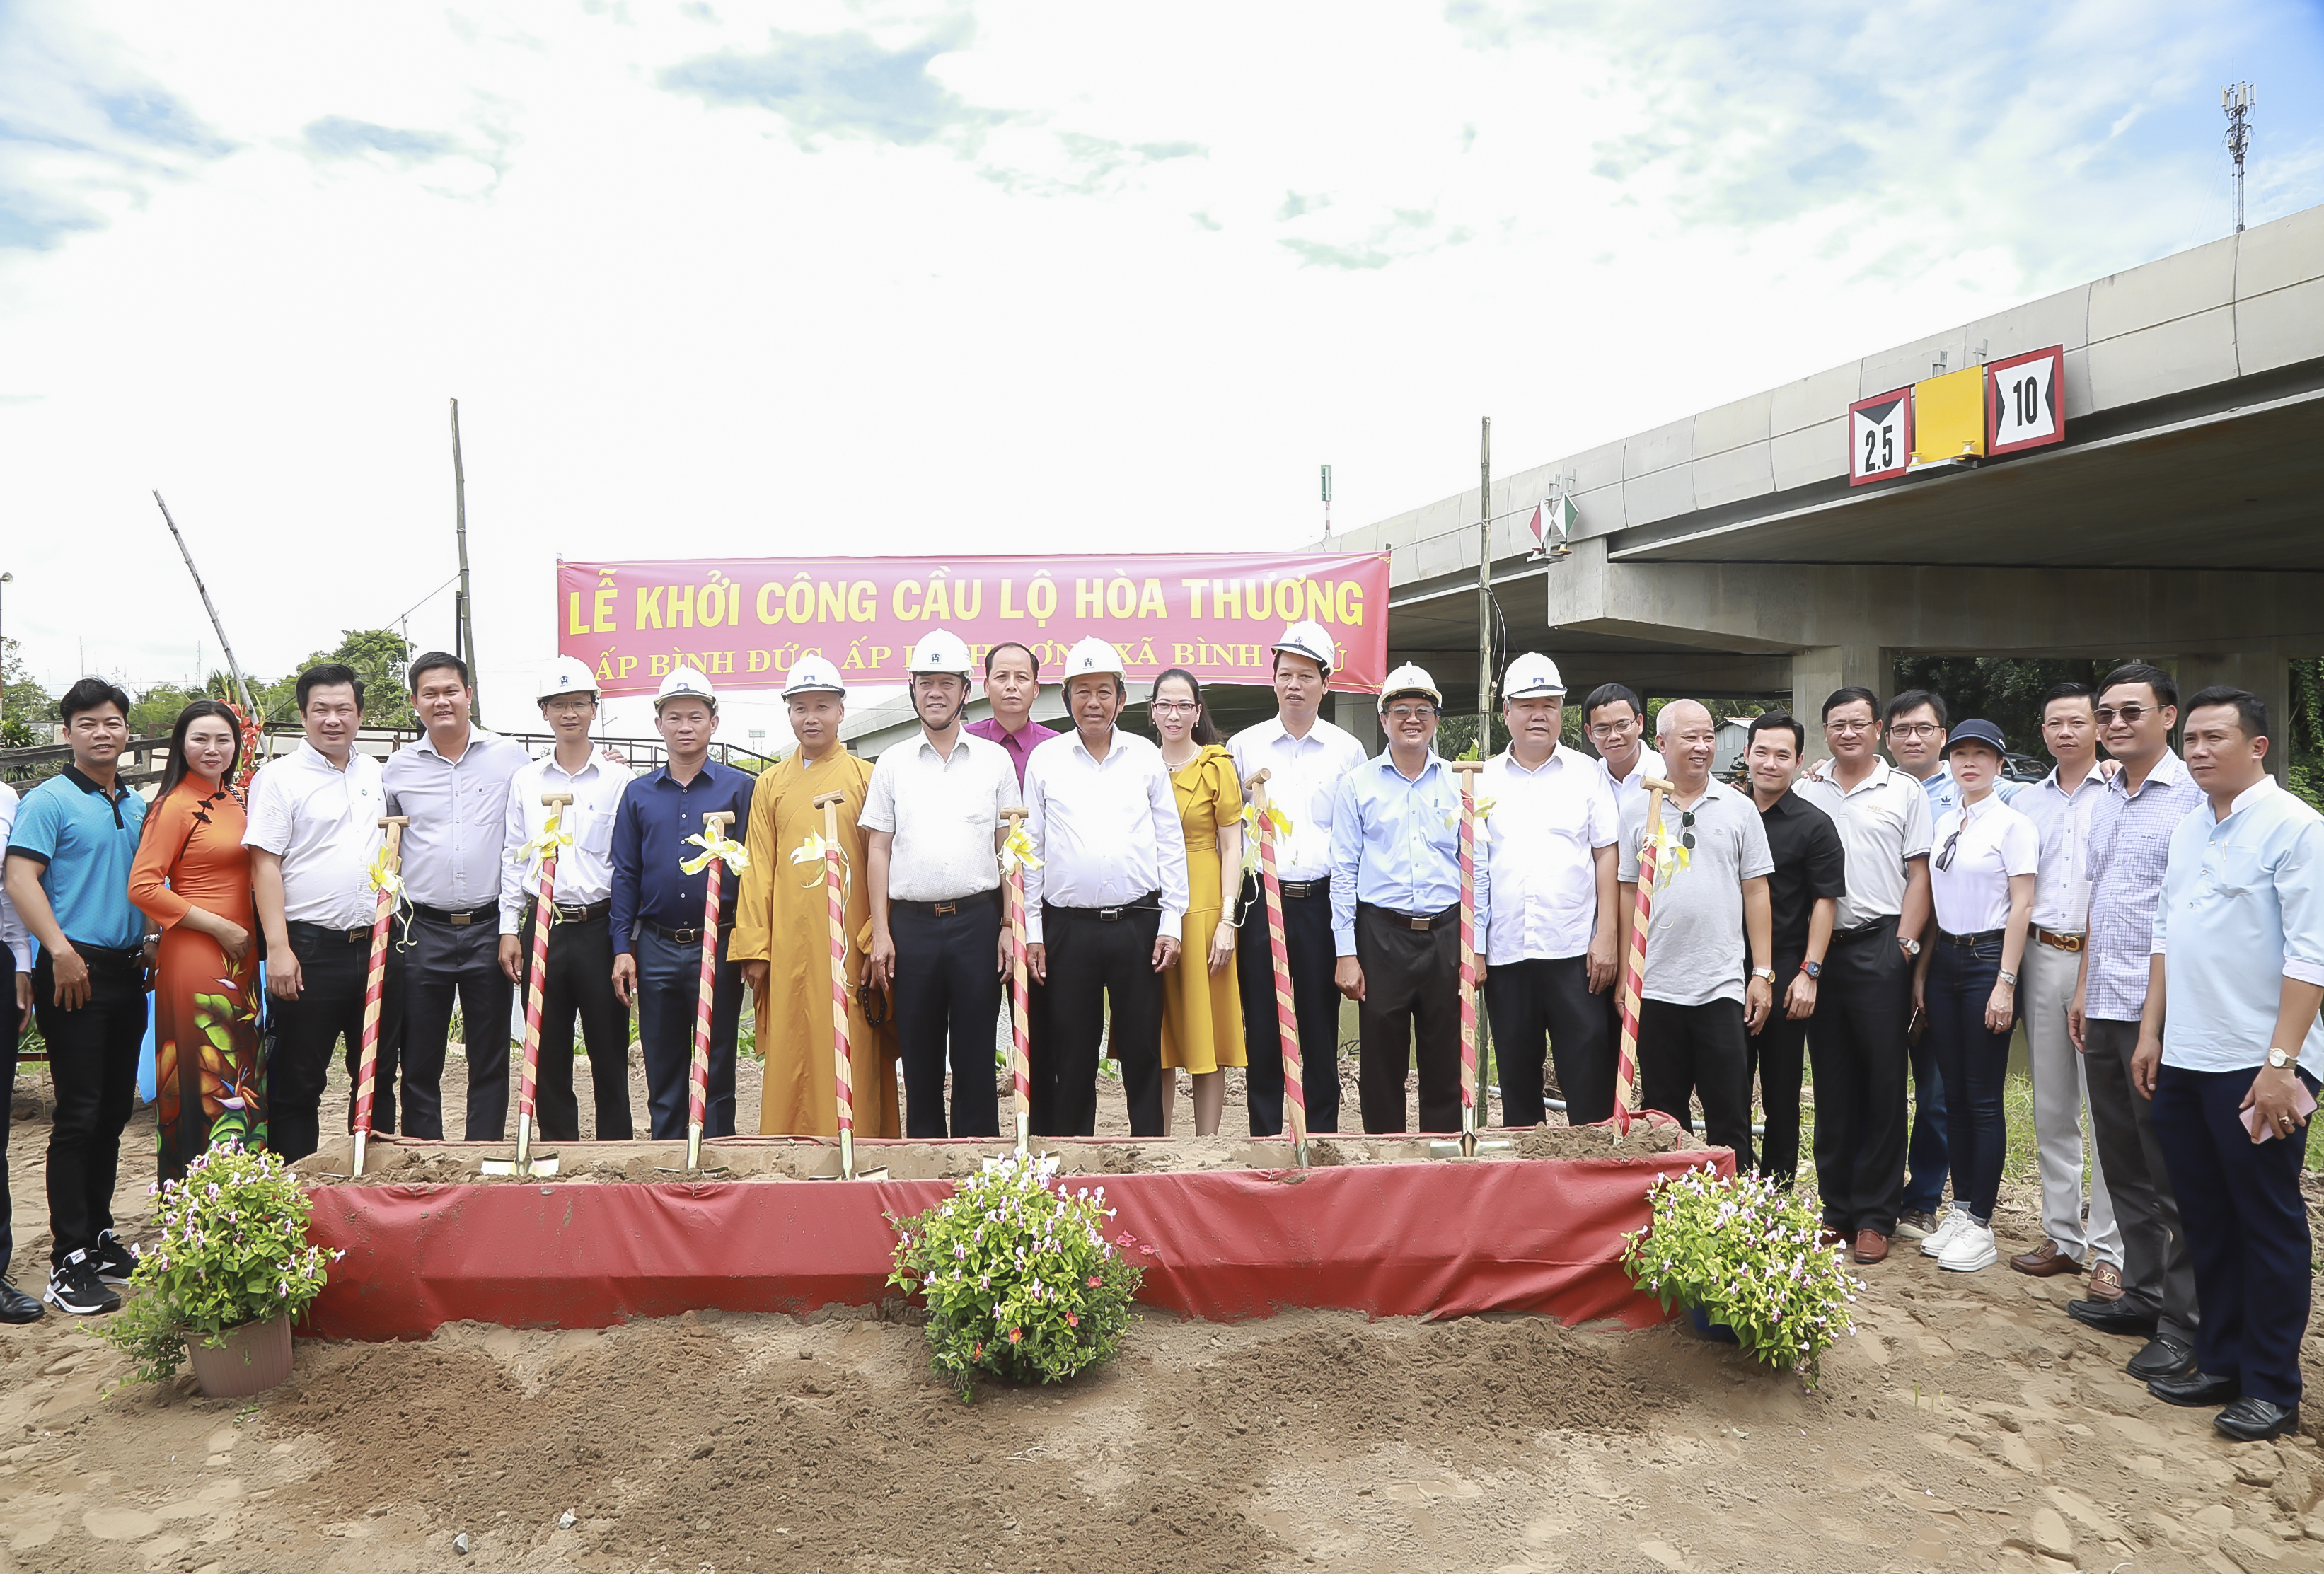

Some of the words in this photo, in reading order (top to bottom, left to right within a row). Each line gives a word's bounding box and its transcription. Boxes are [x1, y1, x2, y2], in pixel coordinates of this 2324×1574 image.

[2013, 376, 2038, 427] 10
[1865, 424, 1893, 473] 2.5
[569, 568, 618, 635] LỄ
[635, 569, 740, 630] KHỞI
[756, 572, 877, 625] CÔNG
[892, 566, 982, 621] CẦU
[1000, 569, 1058, 628] LỘ
[1076, 568, 1168, 619] HÒA
[594, 646, 638, 681] ẤP
[648, 646, 736, 677] BÌNH
[840, 635, 892, 669] ẤP
[1111, 637, 1160, 665] XÃ
[1172, 636, 1264, 666] BÌNH
